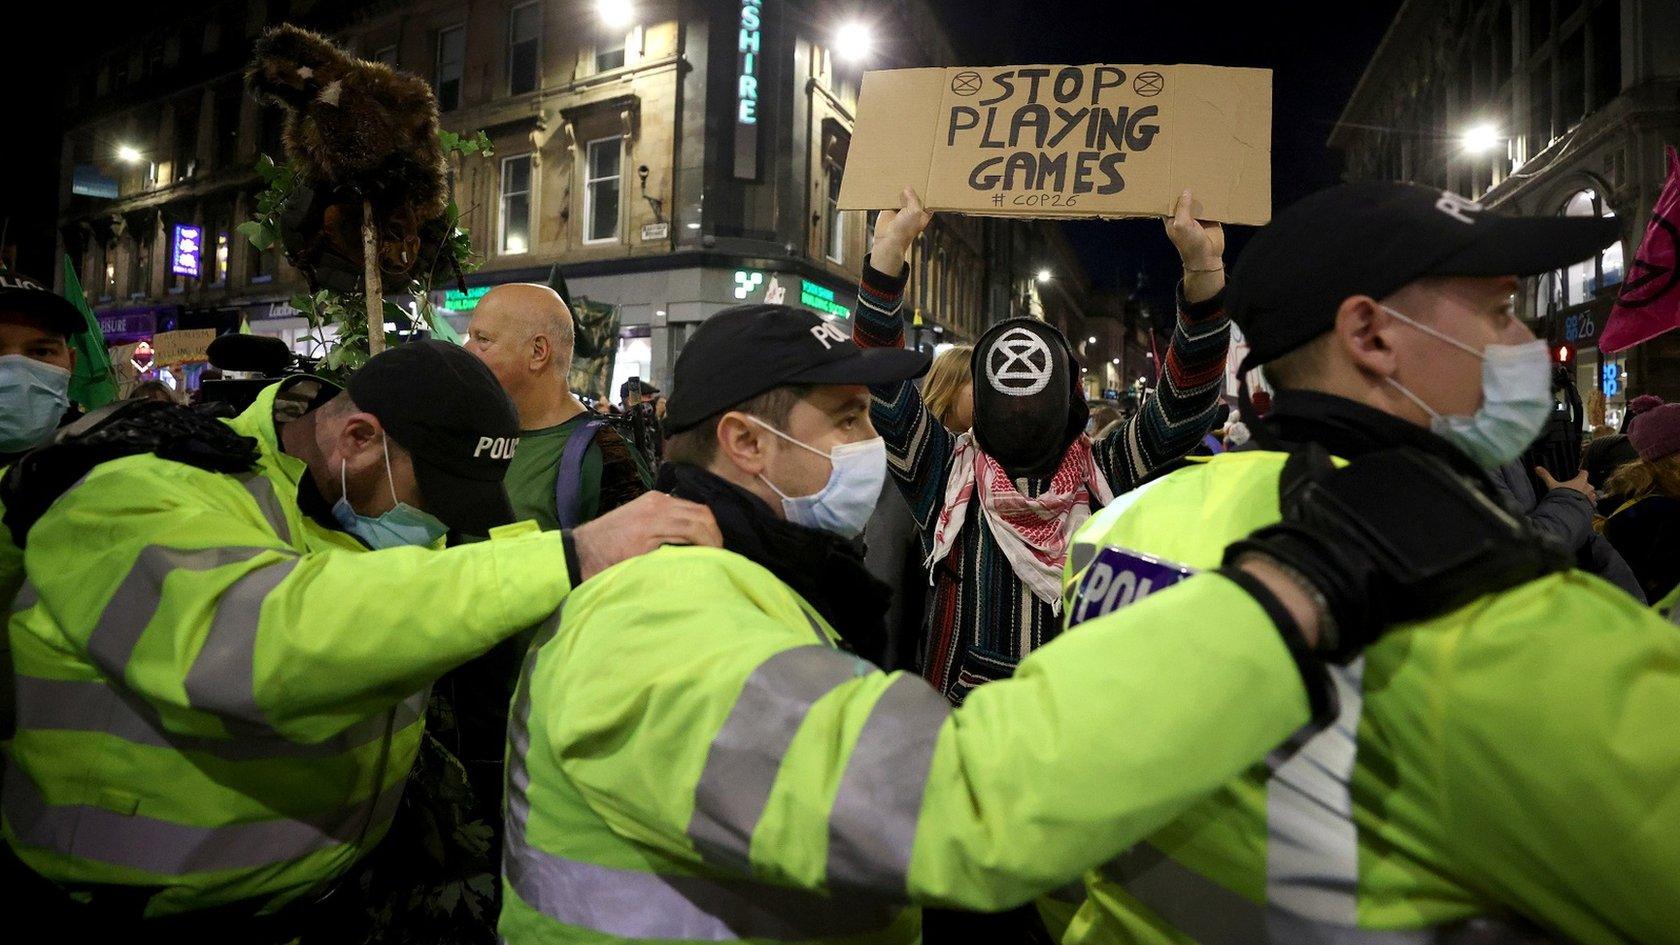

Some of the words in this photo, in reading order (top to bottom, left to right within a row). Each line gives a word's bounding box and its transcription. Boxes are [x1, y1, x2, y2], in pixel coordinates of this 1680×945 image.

[738, 0, 761, 124] SHIRE
[978, 67, 1127, 106] STOP
[947, 104, 1161, 151] PLAYING
[968, 151, 1127, 195] GAMES
[1012, 194, 1081, 207] COP26
